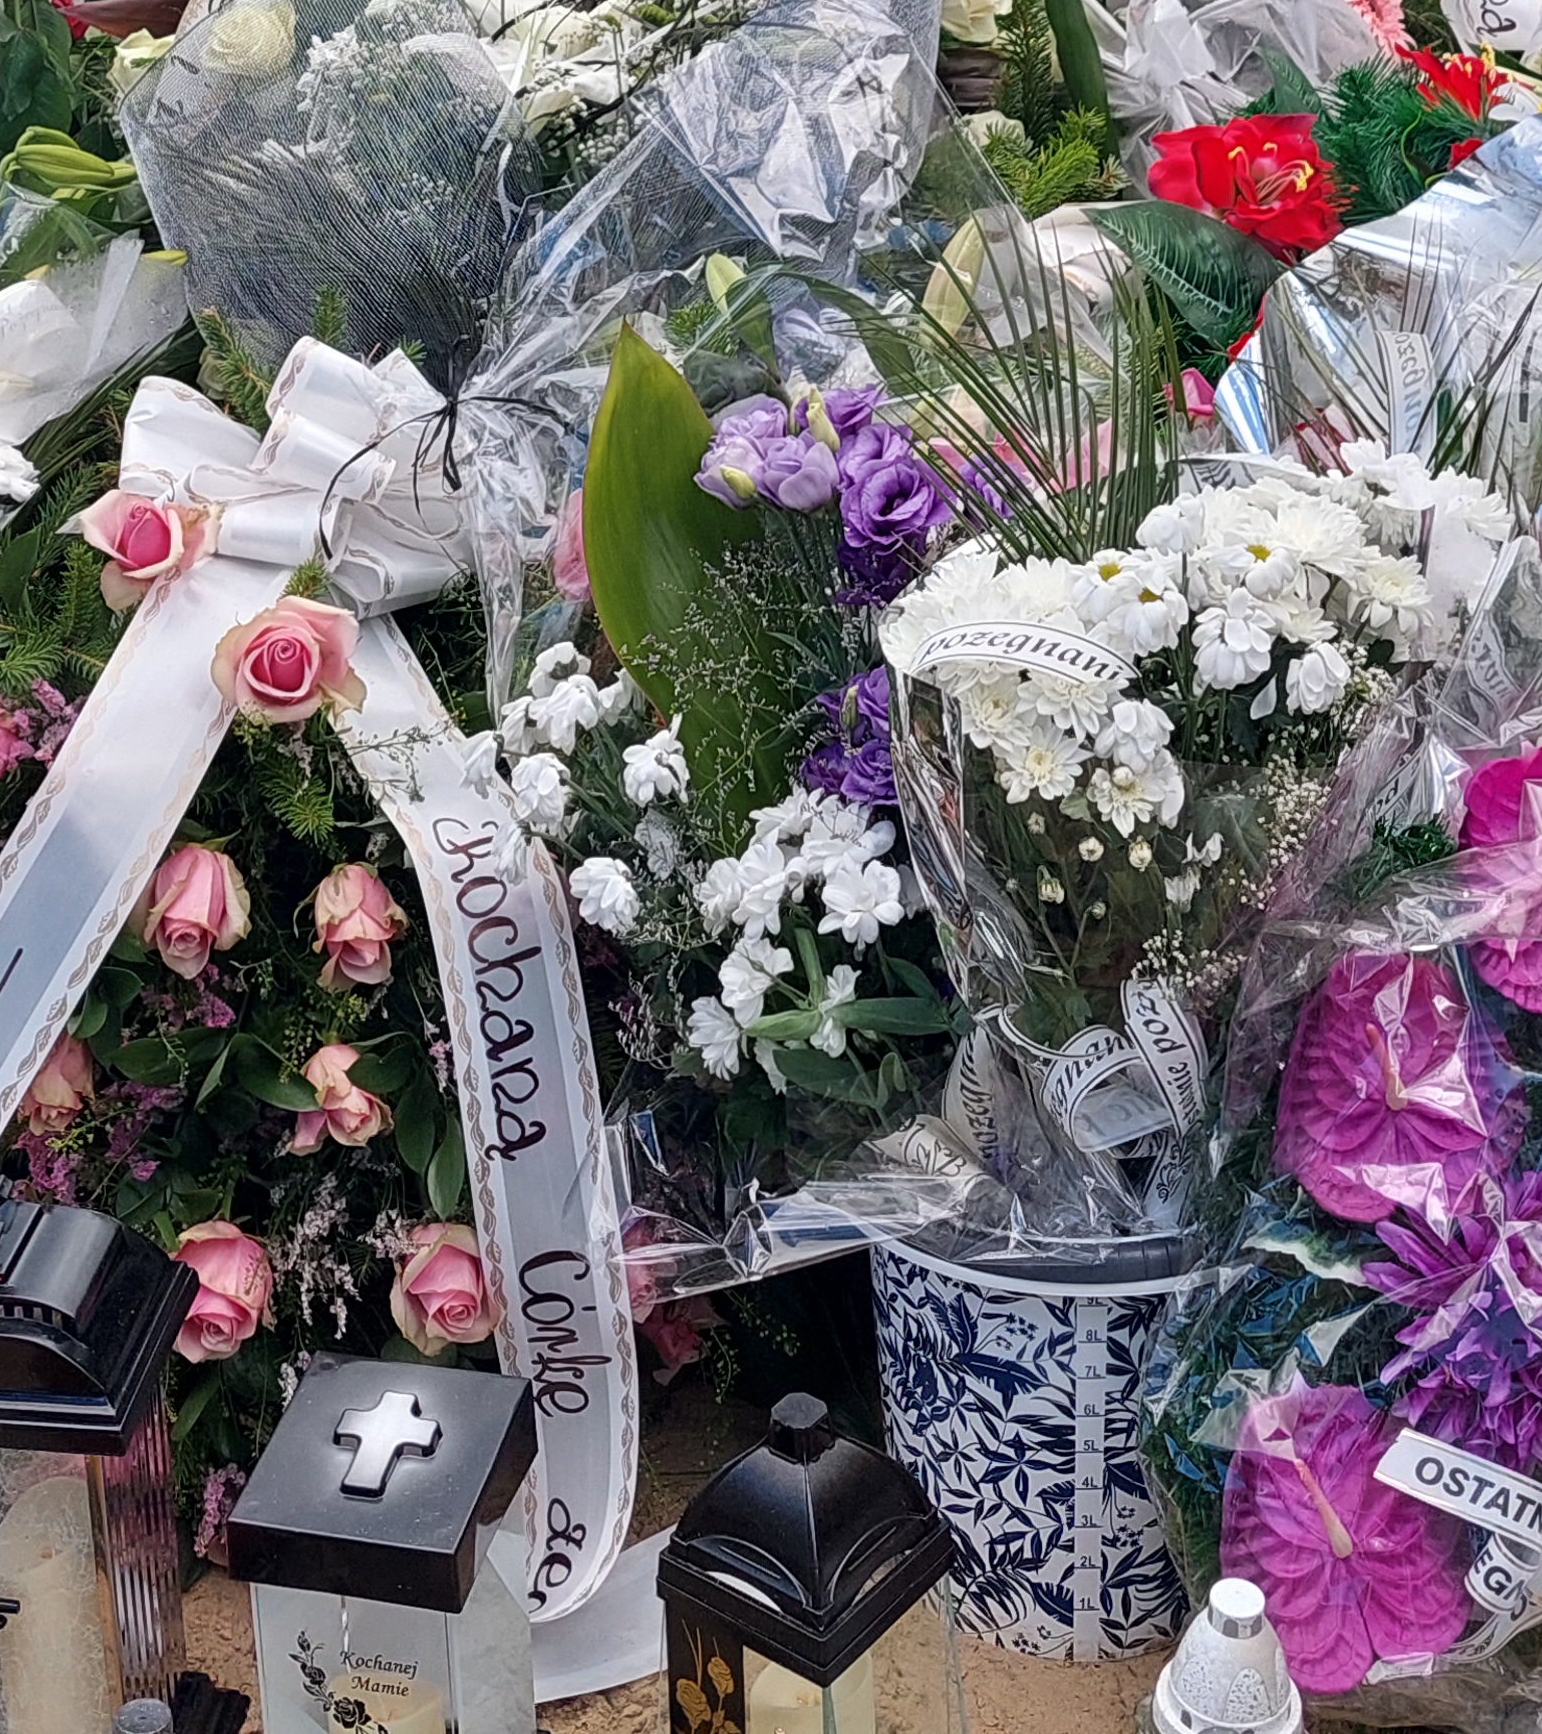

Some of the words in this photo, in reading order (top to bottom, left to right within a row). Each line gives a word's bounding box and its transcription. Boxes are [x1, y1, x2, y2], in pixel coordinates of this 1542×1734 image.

[1085, 1329, 1103, 1341] 8L
[1084, 1365, 1101, 1378] 7L
[1083, 1404, 1100, 1415] 6L
[1083, 1439, 1099, 1451] 5L
[1082, 1476, 1098, 1488] 4L
[1081, 1515, 1097, 1526] 3L
[1080, 1556, 1096, 1567] 2L
[1079, 1598, 1095, 1610] 1L
[339, 1650, 419, 1680] Kochanej
[350, 1675, 410, 1697] Mamie
